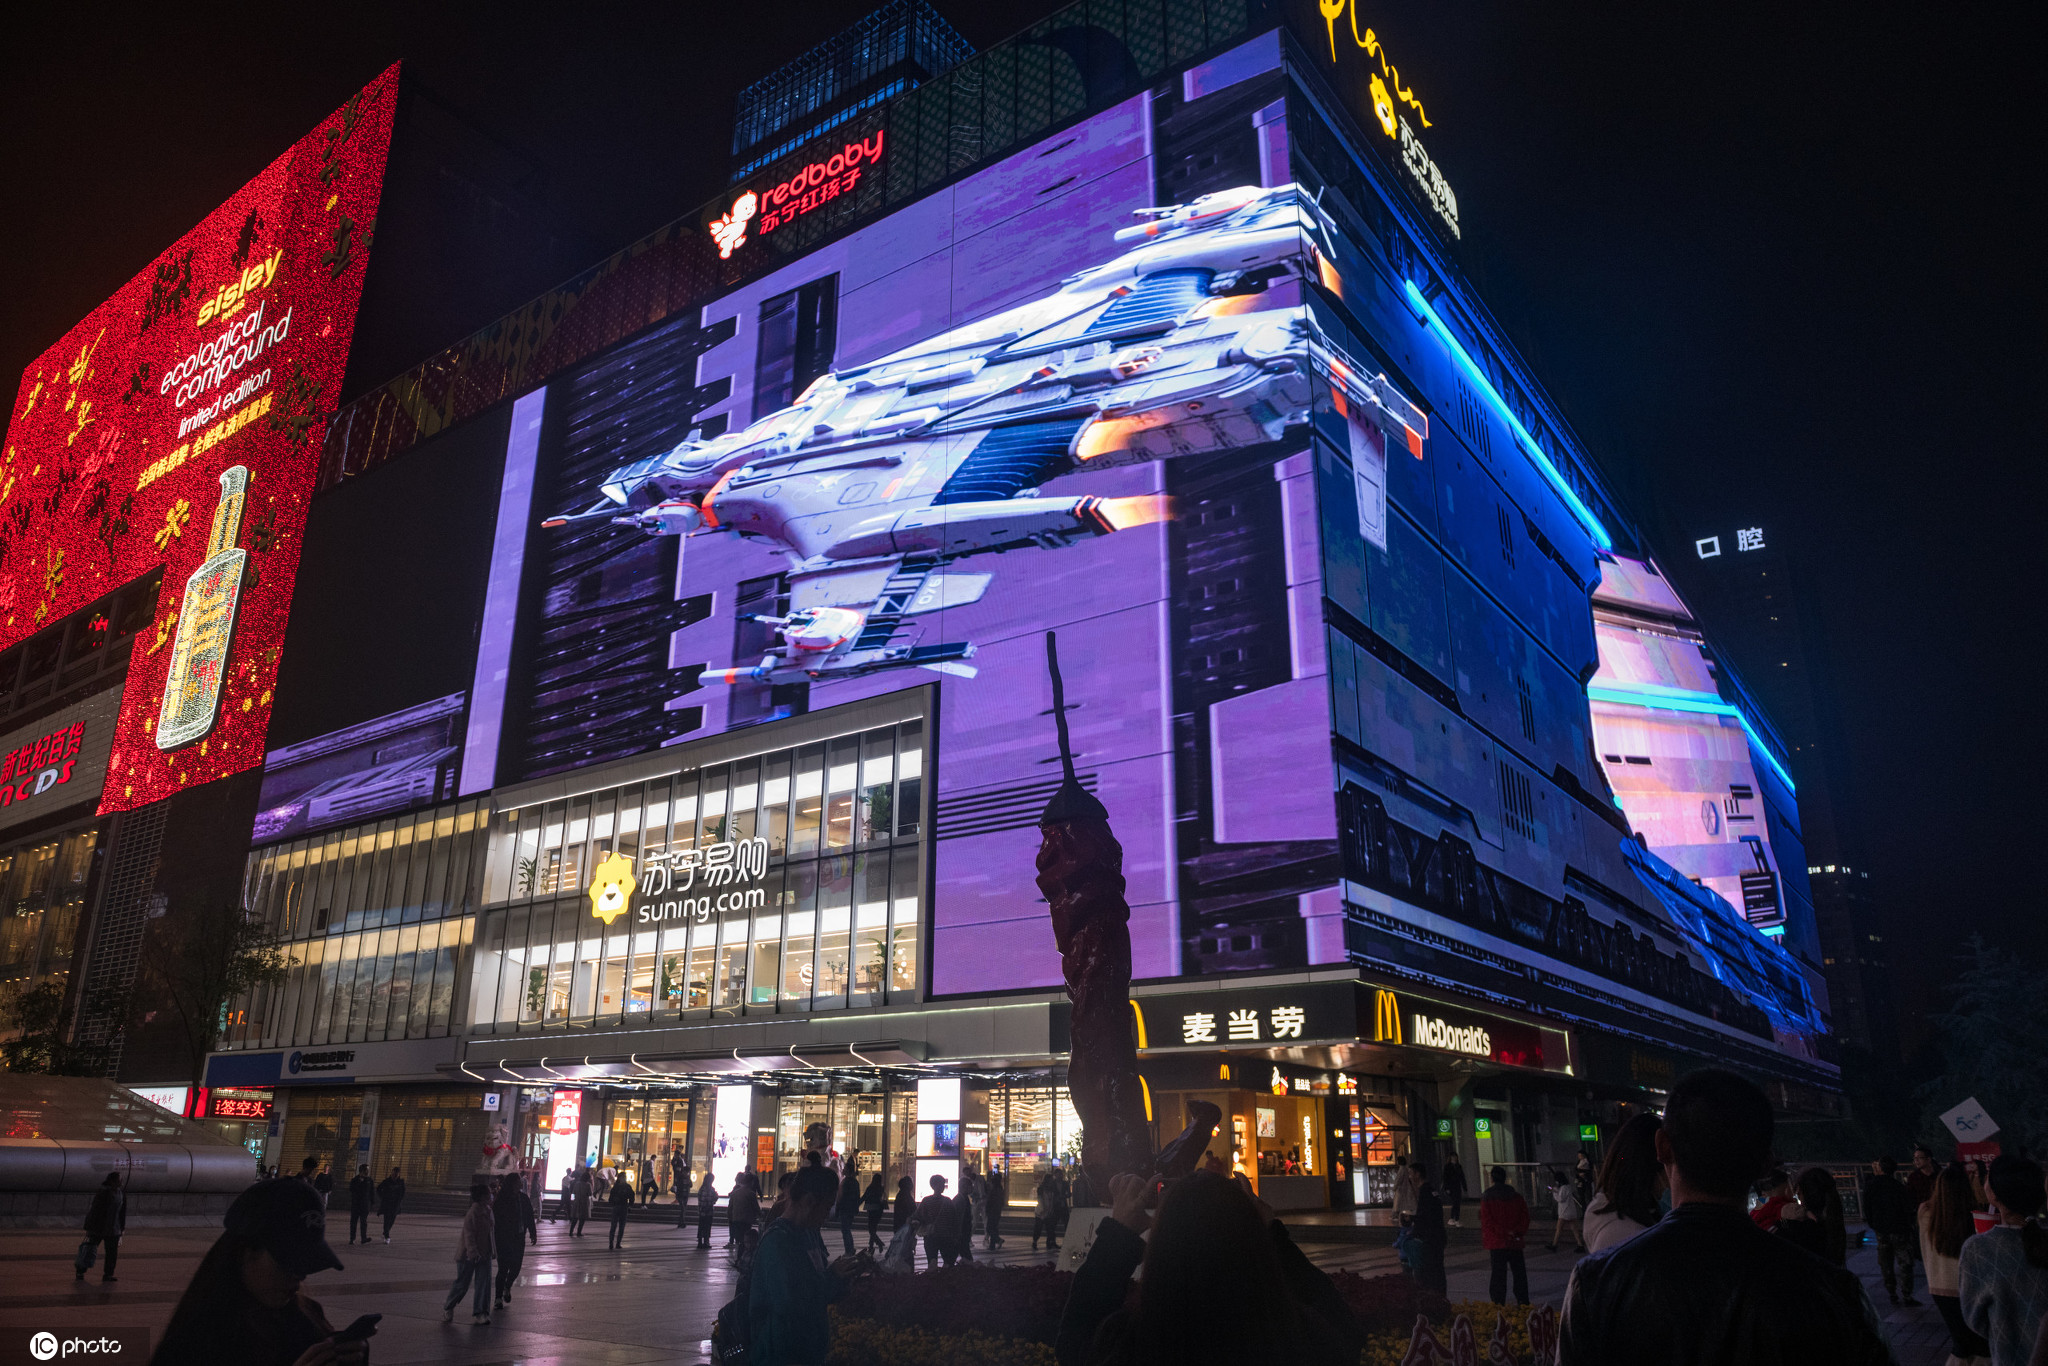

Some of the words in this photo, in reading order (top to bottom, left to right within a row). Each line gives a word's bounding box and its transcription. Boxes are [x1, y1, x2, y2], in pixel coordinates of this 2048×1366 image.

[759, 167, 862, 235] 苏宁红孩子
[760, 129, 884, 213] redbaby
[1402, 150, 1461, 240] suning.com
[196, 248, 283, 327] sisley
[220, 298, 246, 323] PARIS
[160, 299, 266, 395] ecological
[175, 305, 293, 408] compound
[177, 395, 222, 440] limited
[222, 367, 272, 411] edition
[135, 443, 190, 492] 法国希思黎
[1695, 526, 1766, 560] 口腔
[0, 719, 86, 786] 新世纪百货
[640, 836, 769, 897] 苏宁易购
[638, 888, 766, 924] suning.com
[1182, 1005, 1306, 1044] 麦当劳
[1412, 1013, 1492, 1058] McDonald's
